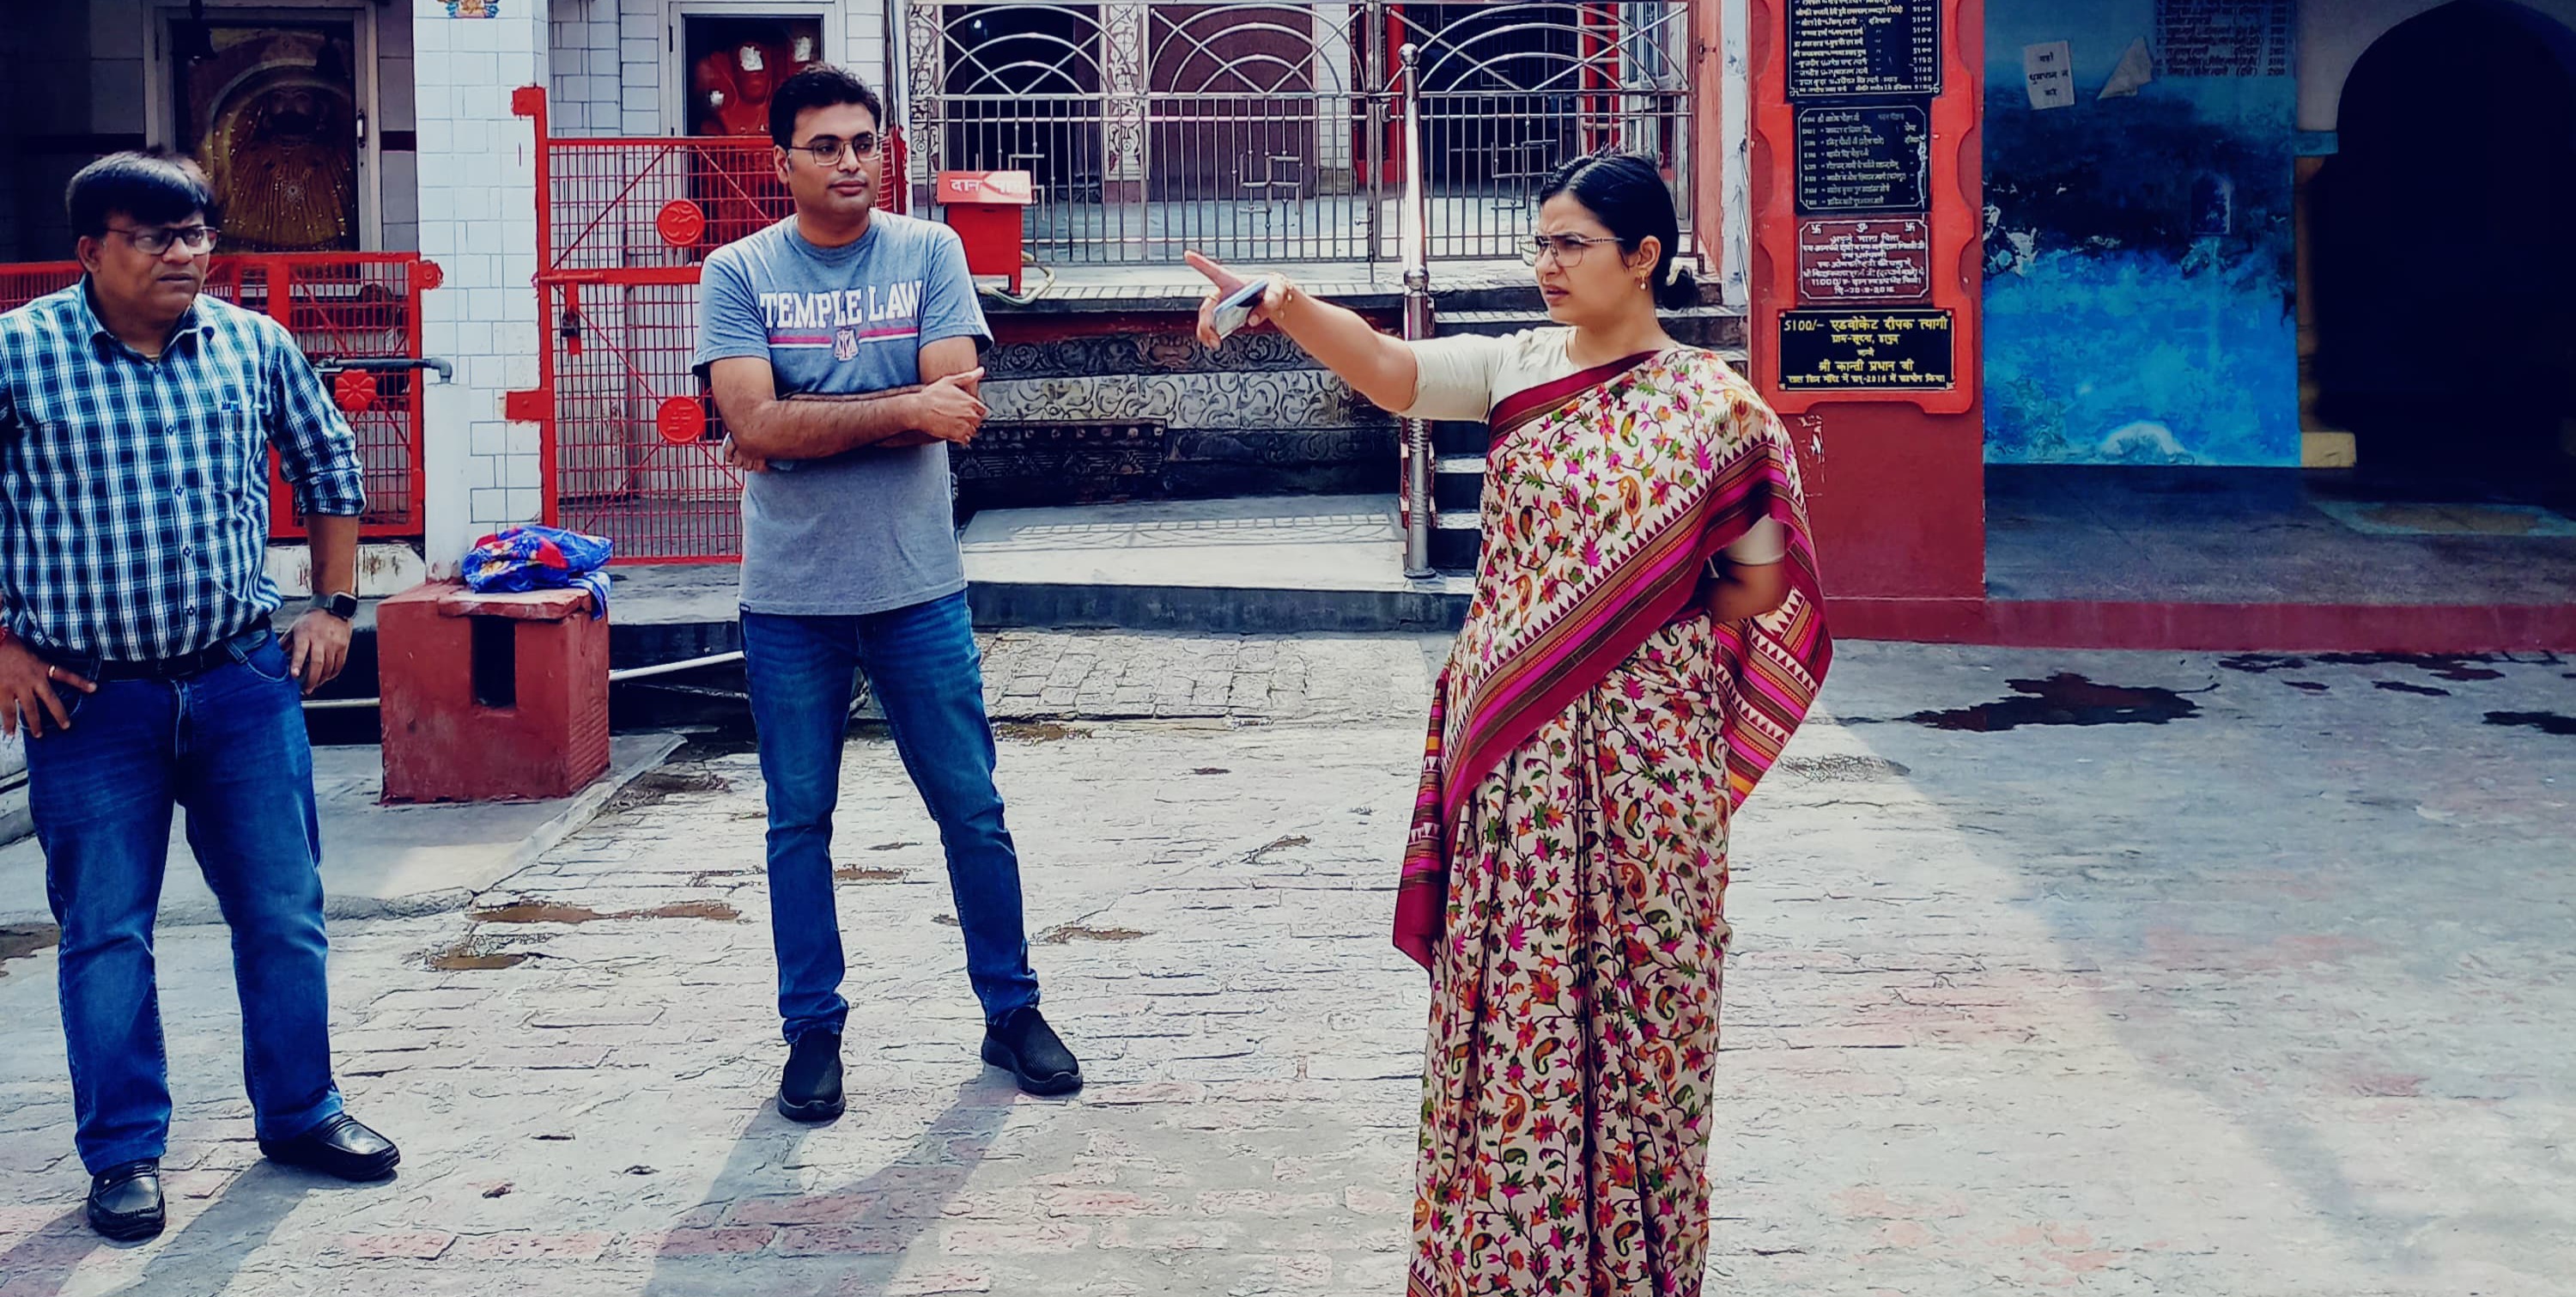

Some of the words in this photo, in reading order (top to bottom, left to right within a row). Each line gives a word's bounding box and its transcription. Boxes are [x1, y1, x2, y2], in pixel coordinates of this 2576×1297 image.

[950, 179, 983, 192] दान
[758, 289, 863, 328] TEMPLE
[868, 280, 923, 322] LAW
[1783, 320, 1825, 332] 5100/-
[1830, 315, 1879, 332] एडवोकेट
[1883, 316, 1915, 331] दीपक
[1918, 315, 1948, 330] त्यागी
[1819, 358, 1831, 371] श्री
[1835, 358, 1863, 371] कान्ती
[1868, 361, 1895, 371] प्रधान
[1899, 358, 1914, 371] जी
